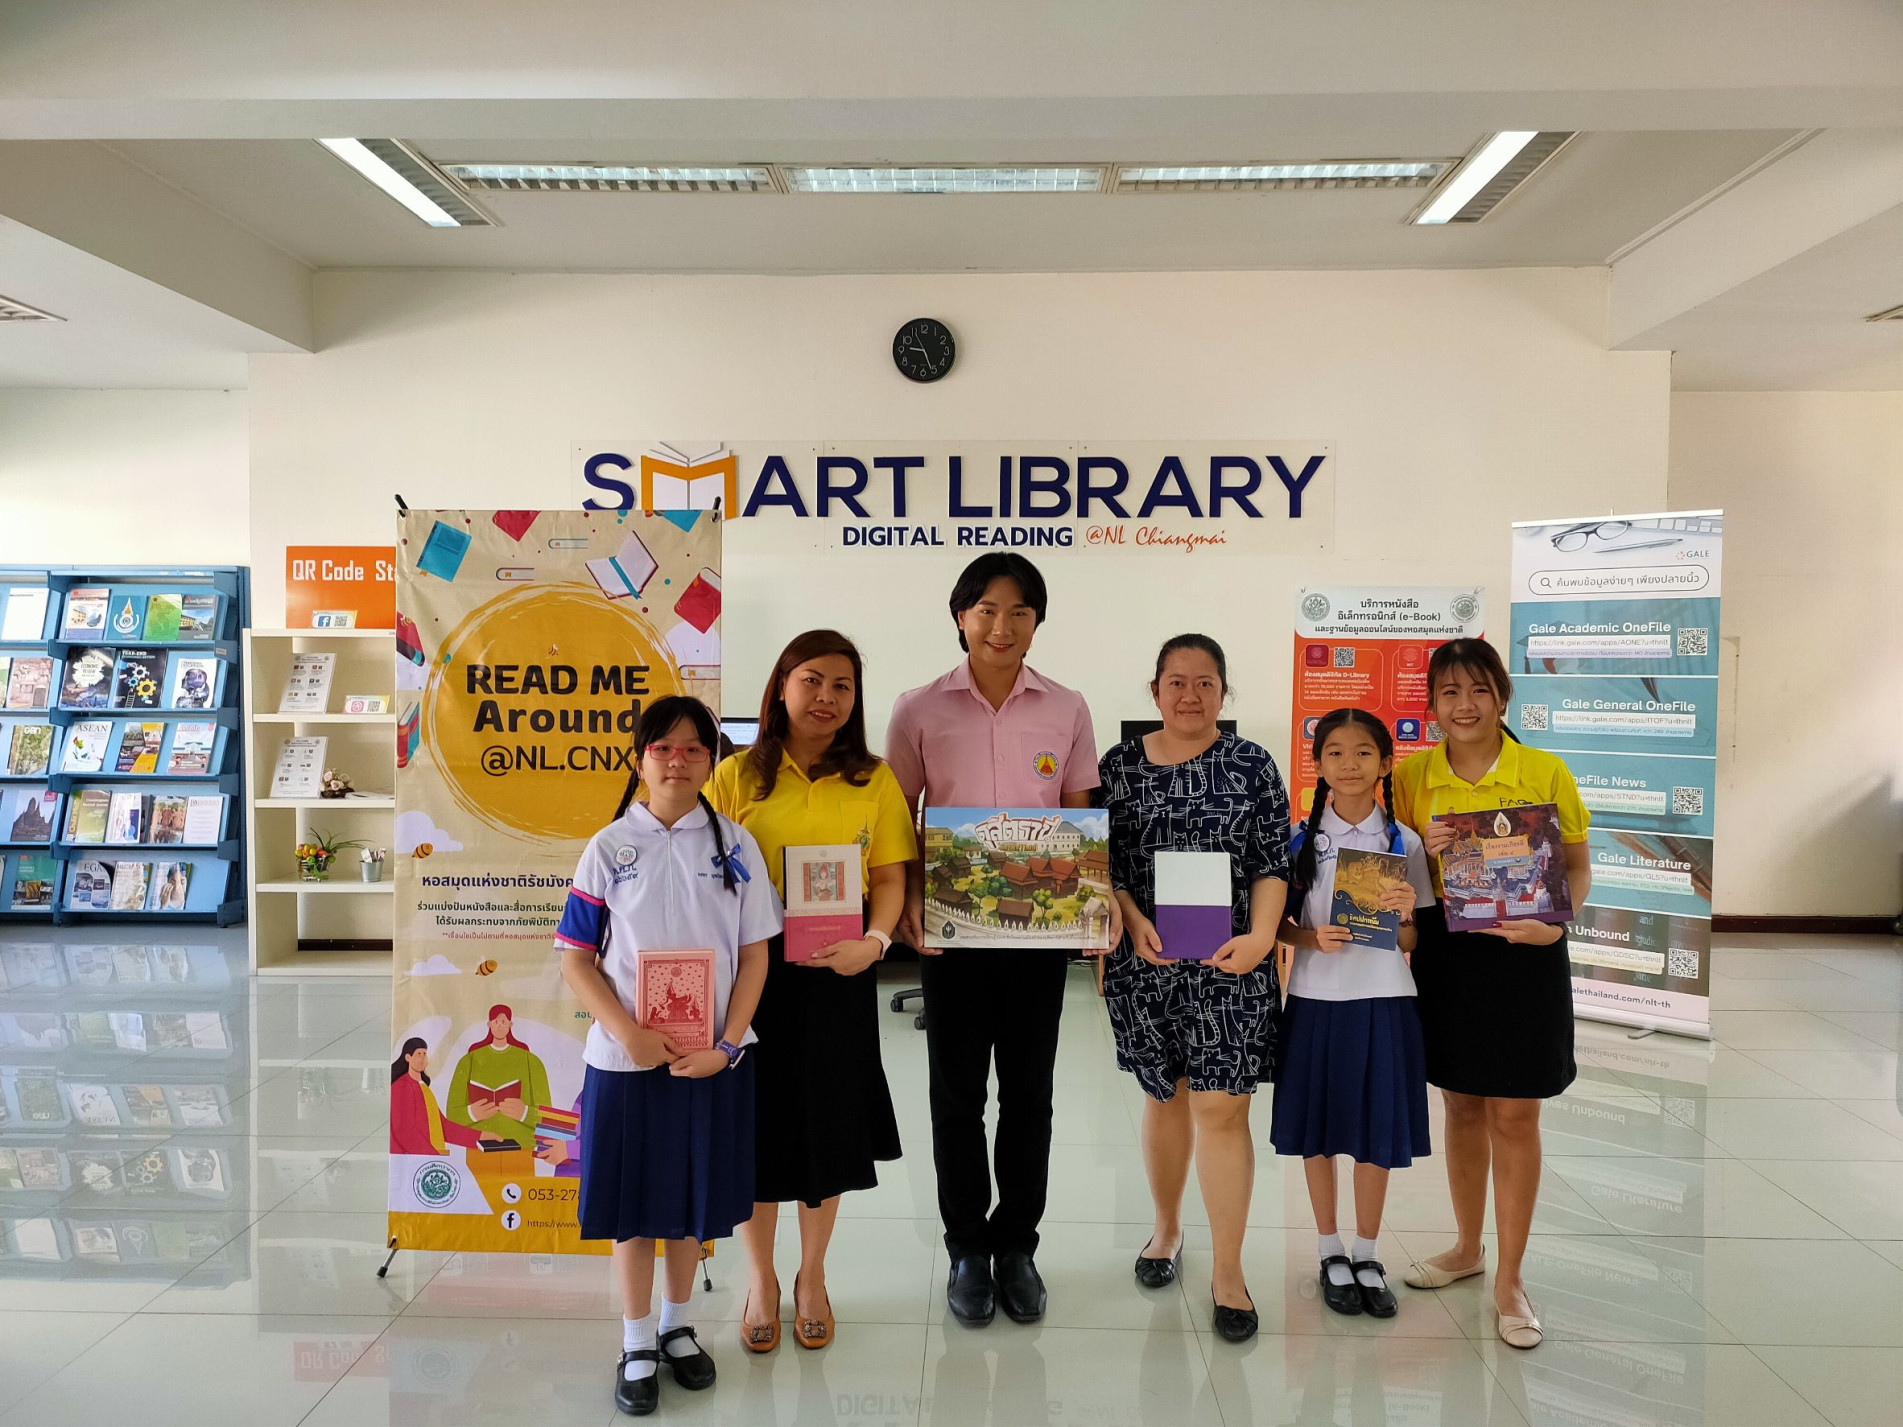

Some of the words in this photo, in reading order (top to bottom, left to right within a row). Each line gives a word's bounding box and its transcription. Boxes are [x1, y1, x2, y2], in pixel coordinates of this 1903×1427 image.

[582, 454, 925, 520] SMART
[949, 454, 1328, 520] LIBRARY
[842, 526, 945, 549] DIGITAL
[957, 526, 1075, 549] READING
[1086, 524, 1126, 548] @NL
[1136, 525, 1229, 553] Chiangmai
[1686, 549, 1710, 559] GALE
[292, 559, 315, 581] QR
[322, 559, 364, 581] Code
[1556, 574, 1634, 589] ค้นพบข้อมูลง่ายๆ
[1360, 598, 1419, 609] บริการหนังสือ
[1337, 610, 1397, 621] อิเล็กทรอนิกส์
[1399, 611, 1441, 622] (e-Book)
[1528, 623, 1557, 634] Gale
[1559, 622, 1619, 633] Academic
[1622, 621, 1671, 633] OneFile
[466, 664, 577, 695] READ
[590, 664, 650, 695] ME
[1342, 671, 1370, 680] D-Library
[1562, 699, 1590, 710] Gale
[1593, 699, 1643, 711] General
[1646, 700, 1696, 712] OneFile
[473, 699, 641, 733] Around
[76, 724, 109, 733] ASEAN
[480, 745, 635, 776] @NL.CNX
[1612, 776, 1647, 788] News
[1598, 852, 1627, 865] Gale
[1630, 854, 1692, 871] Literature
[1575, 926, 1630, 942] Unbound
[528, 1188, 580, 1201] 053-27
